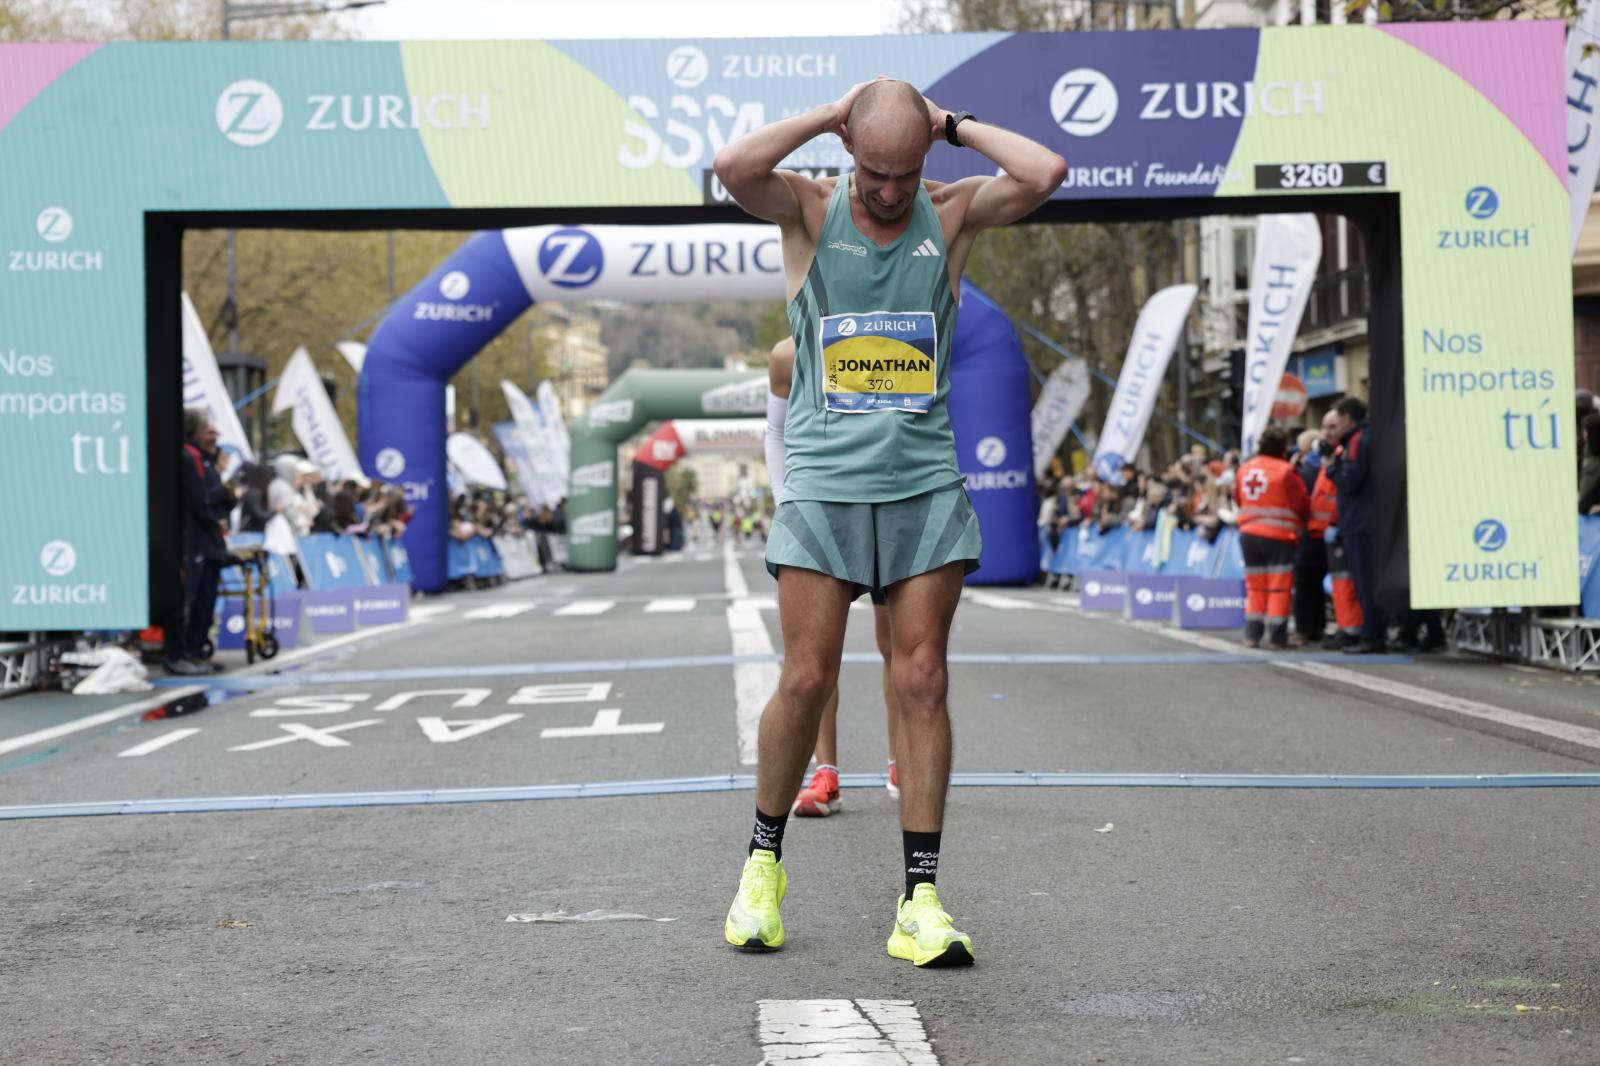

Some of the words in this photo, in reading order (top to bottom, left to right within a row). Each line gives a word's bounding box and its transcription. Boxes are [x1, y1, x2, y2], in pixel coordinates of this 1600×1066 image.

[722, 54, 837, 78] ZURICH
[305, 94, 491, 131] ZURICH
[1140, 81, 1325, 119] ZURICH
[1060, 166, 1133, 188] URICH
[1280, 163, 1343, 188] 3260
[1437, 228, 1530, 249] ZURICH
[9, 250, 103, 271] ZURICH
[628, 238, 782, 277] ZURIC
[414, 301, 493, 322] ZURICH
[863, 320, 917, 332] ZURICH
[1422, 329, 1483, 354] Nos
[0, 352, 54, 377] Nos
[838, 359, 930, 372] JONATHAN
[868, 379, 894, 391] 370
[1114, 331, 1164, 439] ZURICH
[1422, 366, 1556, 398] importas
[0, 389, 126, 419] mportas
[1502, 398, 1560, 450] tú
[71, 420, 130, 474] tú
[1445, 561, 1539, 582] ZURICH
[12, 583, 107, 605] ZURICH
[248, 682, 613, 718] BUS
